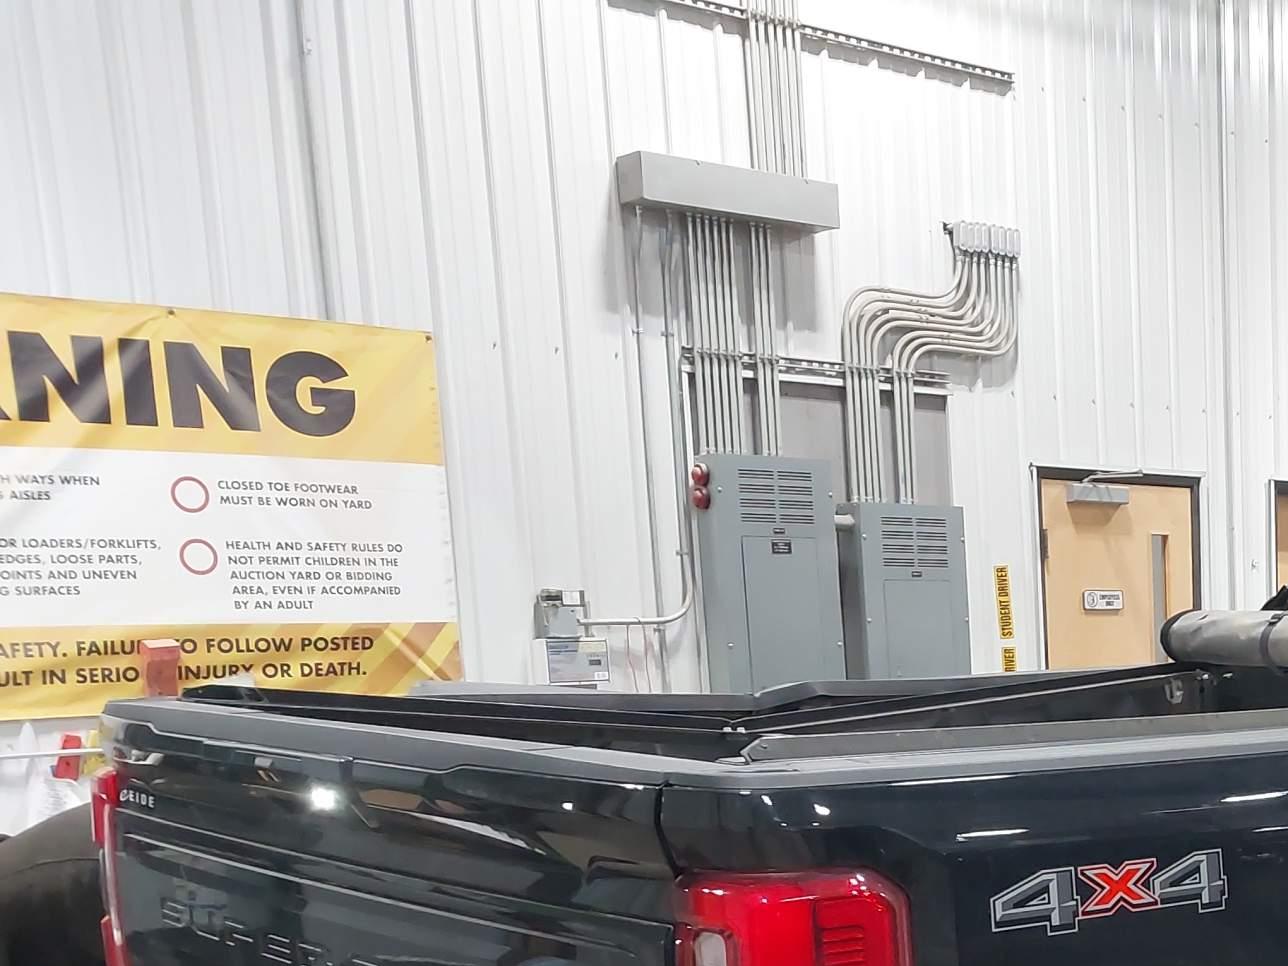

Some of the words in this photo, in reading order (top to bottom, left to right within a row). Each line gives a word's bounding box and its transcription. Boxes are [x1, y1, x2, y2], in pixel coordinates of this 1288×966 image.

[0, 331, 356, 437] NING
[15, 474, 55, 485] WAYS
[59, 475, 100, 486] WHEN
[217, 480, 264, 491] CLOSED
[267, 482, 290, 492] TOE
[294, 483, 359, 495] FOOTWEAR
[10, 490, 51, 500] AISLES
[219, 495, 253, 505] MUST
[257, 497, 271, 506] BE
[275, 497, 316, 508] WORN
[319, 498, 338, 508] ON
[343, 500, 372, 510] YARD
[22, 538, 161, 550] LOADERS/FORKLIFTS,
[225, 540, 271, 551] HEALTH
[276, 541, 303, 551] AND
[307, 542, 347, 552] SAFETY
[351, 543, 384, 553] RULES
[387, 544, 403, 553] DO
[50, 554, 94, 565] LOOSE
[98, 554, 142, 566] PARTS,
[228, 556, 254, 566] NOT
[258, 556, 300, 566] PERMIT
[304, 557, 361, 567] CHILDREN
[364, 558, 377, 567] IN
[381, 558, 399, 567] THE
[48, 570, 78, 580] AND
[82, 570, 137, 580] UNEVEN
[230, 571, 285, 580] AUCTION
[289, 571, 321, 580] YARD
[325, 571, 342, 581] OR
[346, 572, 393, 581] BIDDING
[996, 567, 1008, 597] DRIVER
[14, 586, 81, 596] SURFACES
[232, 586, 269, 596] AREA,
[272, 586, 303, 595] EVEN
[307, 586, 316, 595] IF
[320, 586, 401, 596] ACCOMPANIED
[234, 600, 249, 610] BY
[254, 600, 272, 610] AN
[277, 600, 314, 610] ADULT
[999, 600, 1012, 637] STUDENT
[76, 639, 142, 656] FAILU
[175, 639, 197, 654] O
[206, 638, 293, 654] FOLLOW
[301, 636, 374, 651] POSTED
[42, 669, 66, 685] IN
[76, 667, 140, 684] SERIO
[262, 662, 293, 678] OR
[301, 661, 367, 677] DEATH.
